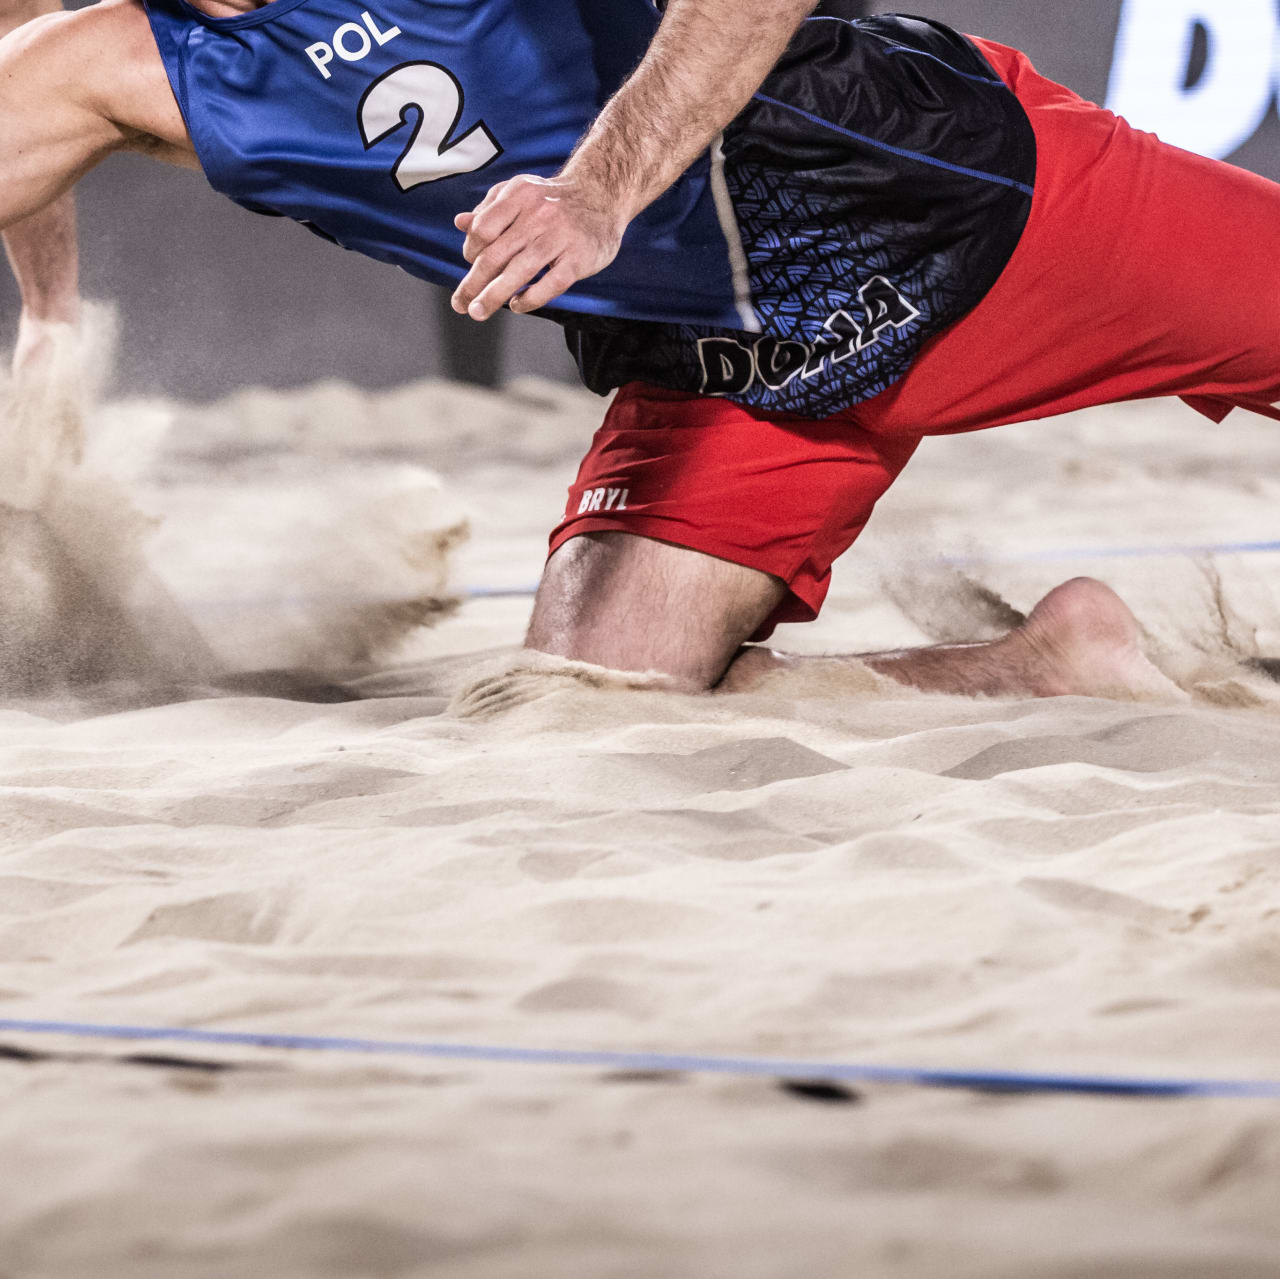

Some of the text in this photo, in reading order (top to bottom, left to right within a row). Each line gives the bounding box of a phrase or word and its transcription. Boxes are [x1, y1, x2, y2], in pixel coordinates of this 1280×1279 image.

[304, 11, 402, 80] POL
[357, 59, 505, 194] 2
[697, 275, 920, 396] DOHA
[577, 487, 629, 515] BRYL
